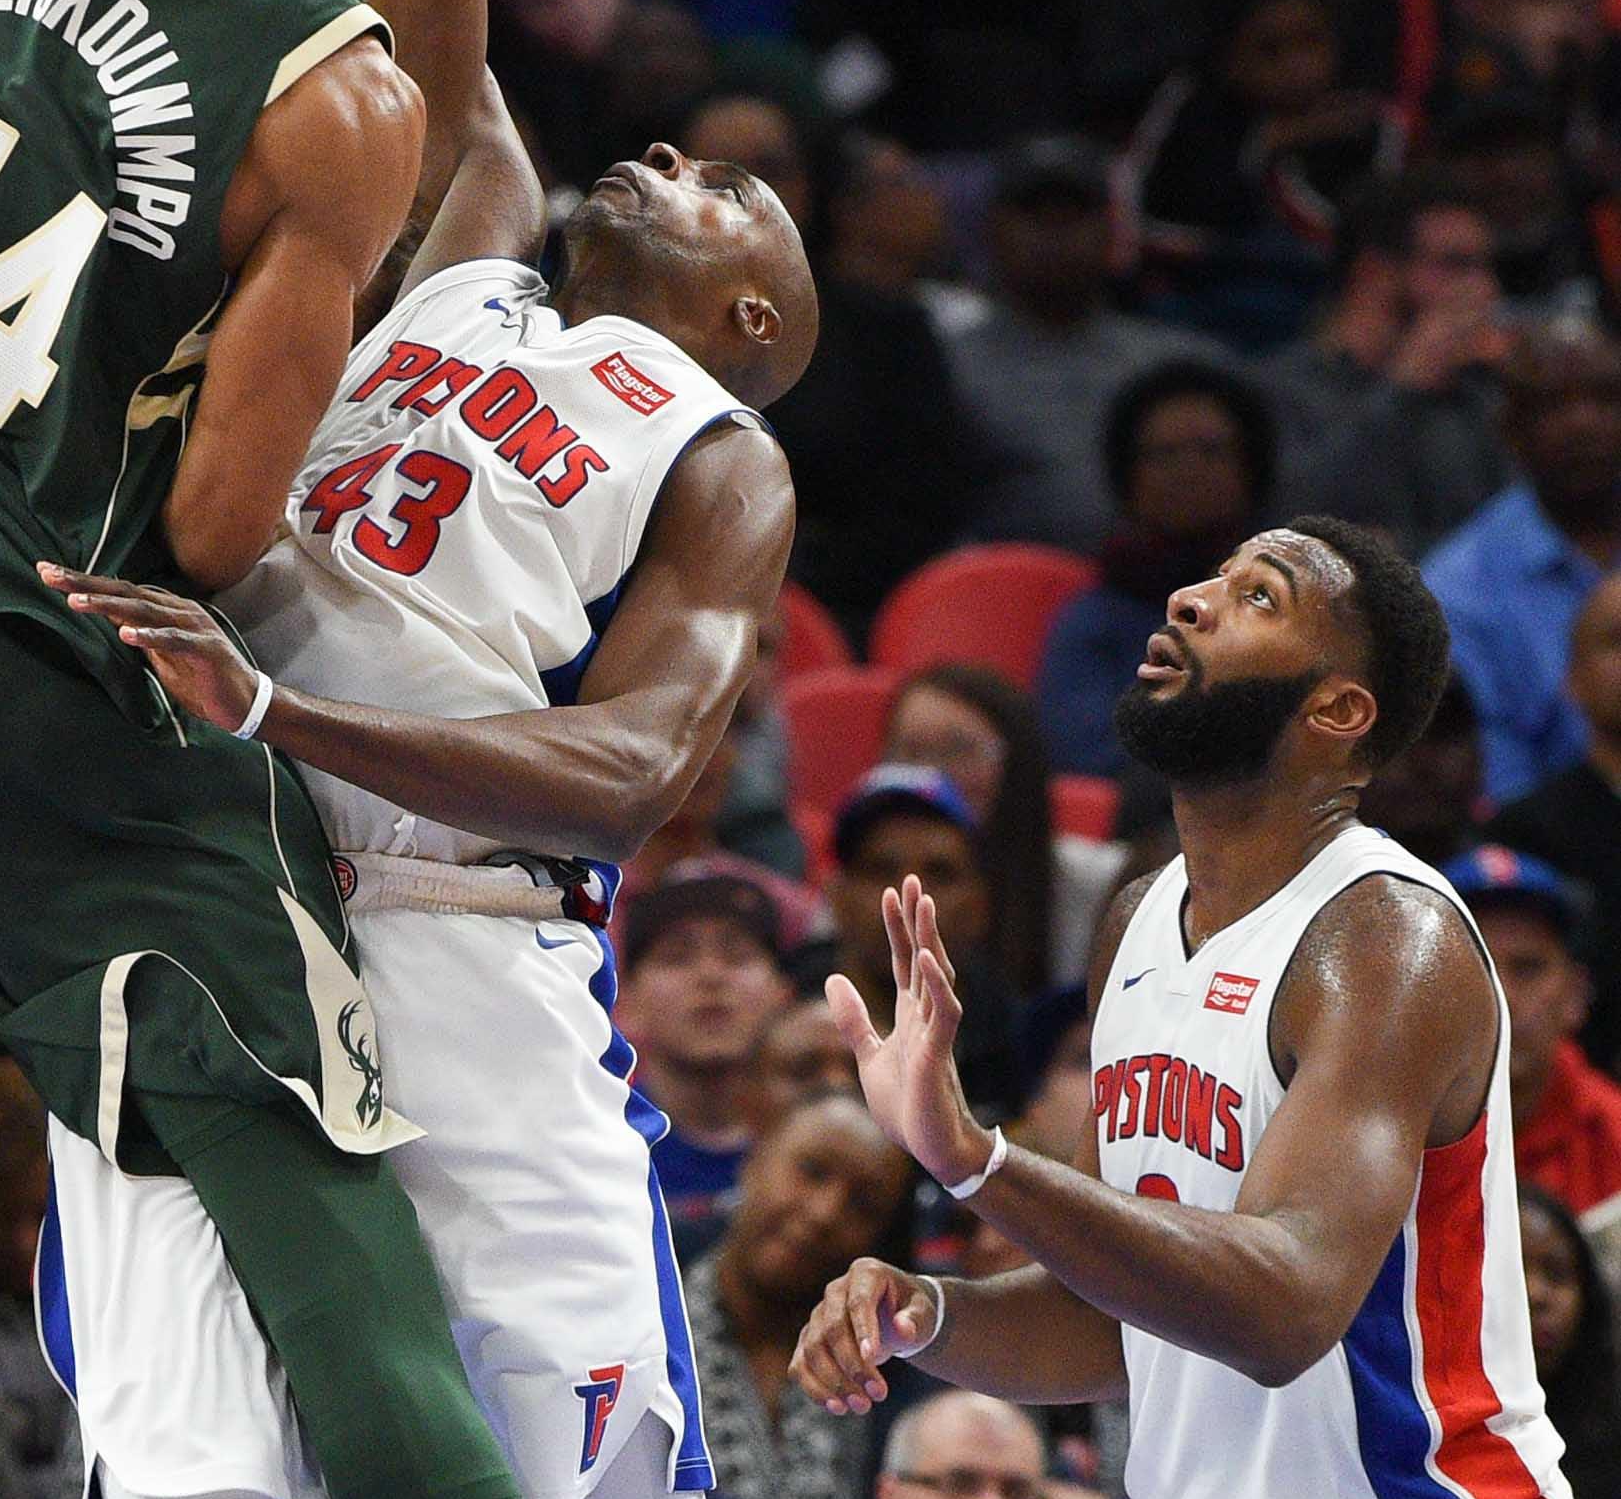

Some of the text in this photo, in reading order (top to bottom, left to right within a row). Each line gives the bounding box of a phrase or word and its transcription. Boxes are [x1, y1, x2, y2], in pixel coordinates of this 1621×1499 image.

[345, 340, 609, 509] PISONS
[607, 357, 668, 403] Flagstar
[301, 442, 473, 577] 43
[1093, 1053, 1245, 1173] PISTONS
